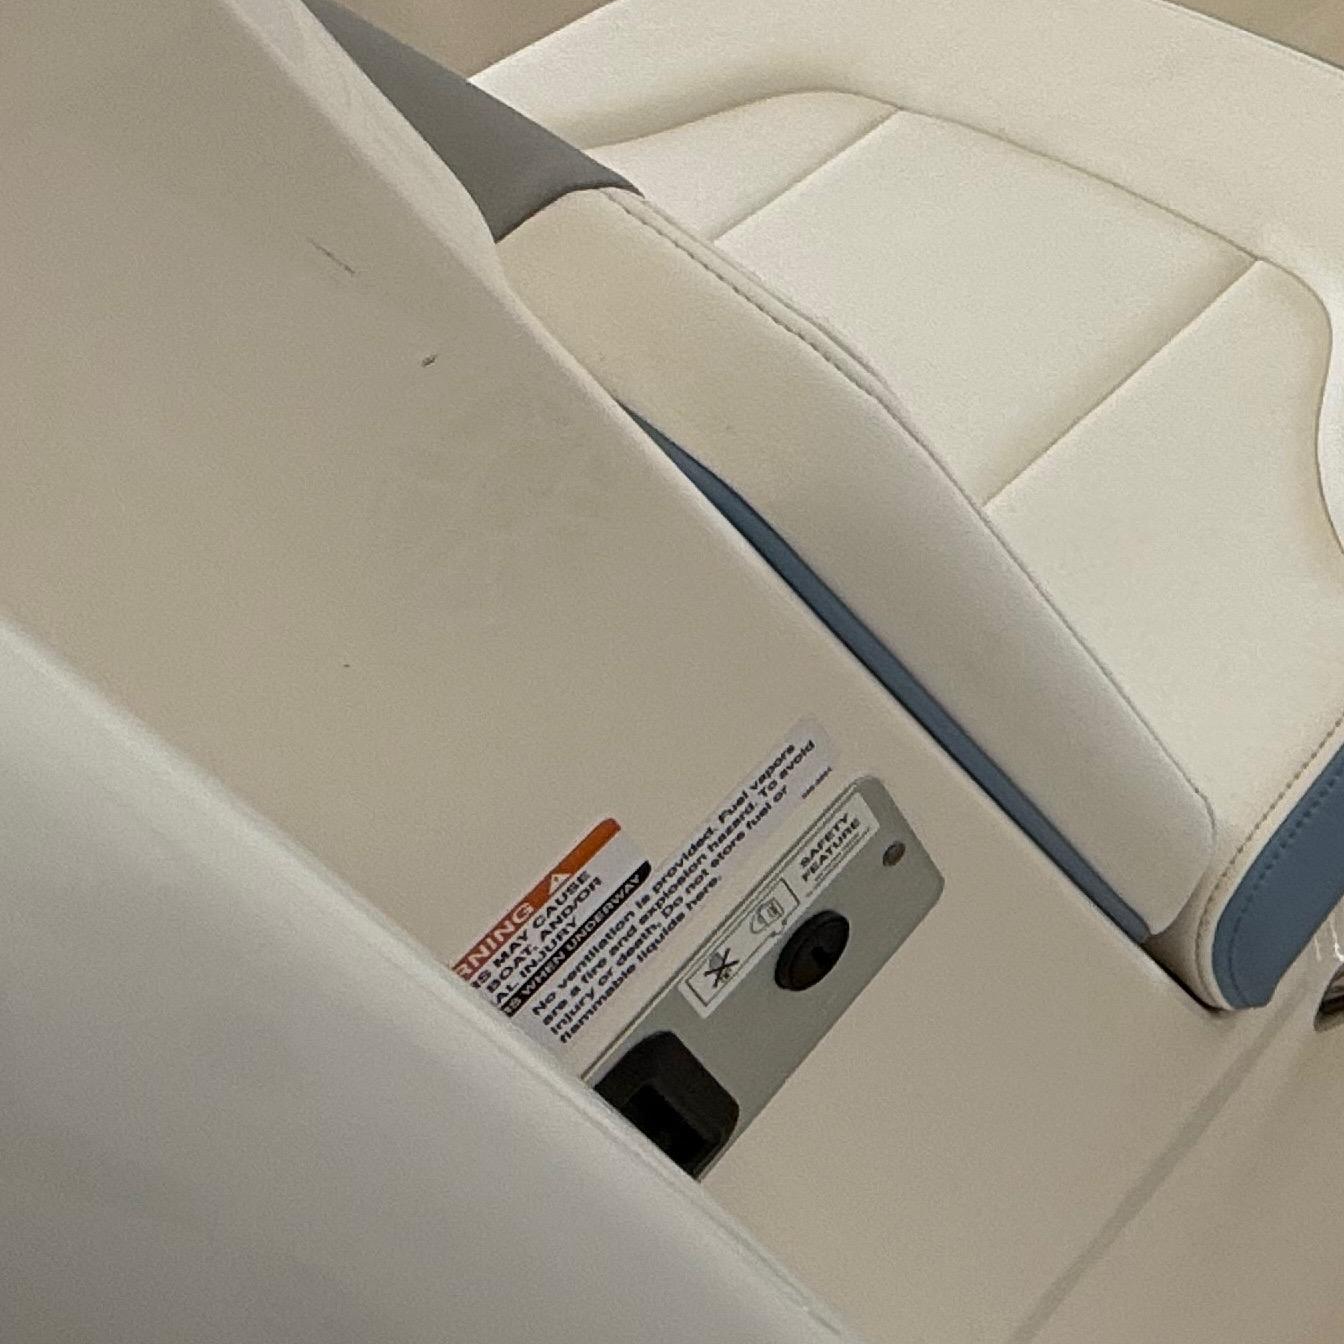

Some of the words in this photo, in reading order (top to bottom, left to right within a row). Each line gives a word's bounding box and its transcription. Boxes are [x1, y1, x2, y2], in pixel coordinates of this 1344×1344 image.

[798, 812, 850, 868] SAFETY
[799, 816, 862, 882] FEATURE
[453, 900, 534, 980] RNING
[492, 928, 530, 968] MAY
[530, 869, 590, 930] CAUSE
[520, 949, 566, 995] WHEN
[564, 872, 641, 951] UNDERWAY
[530, 990, 557, 1016] No
[554, 908, 636, 990] ventilation
[716, 788, 750, 824] Fuel
[557, 962, 638, 1044] flammable
[634, 910, 686, 963] liquids
